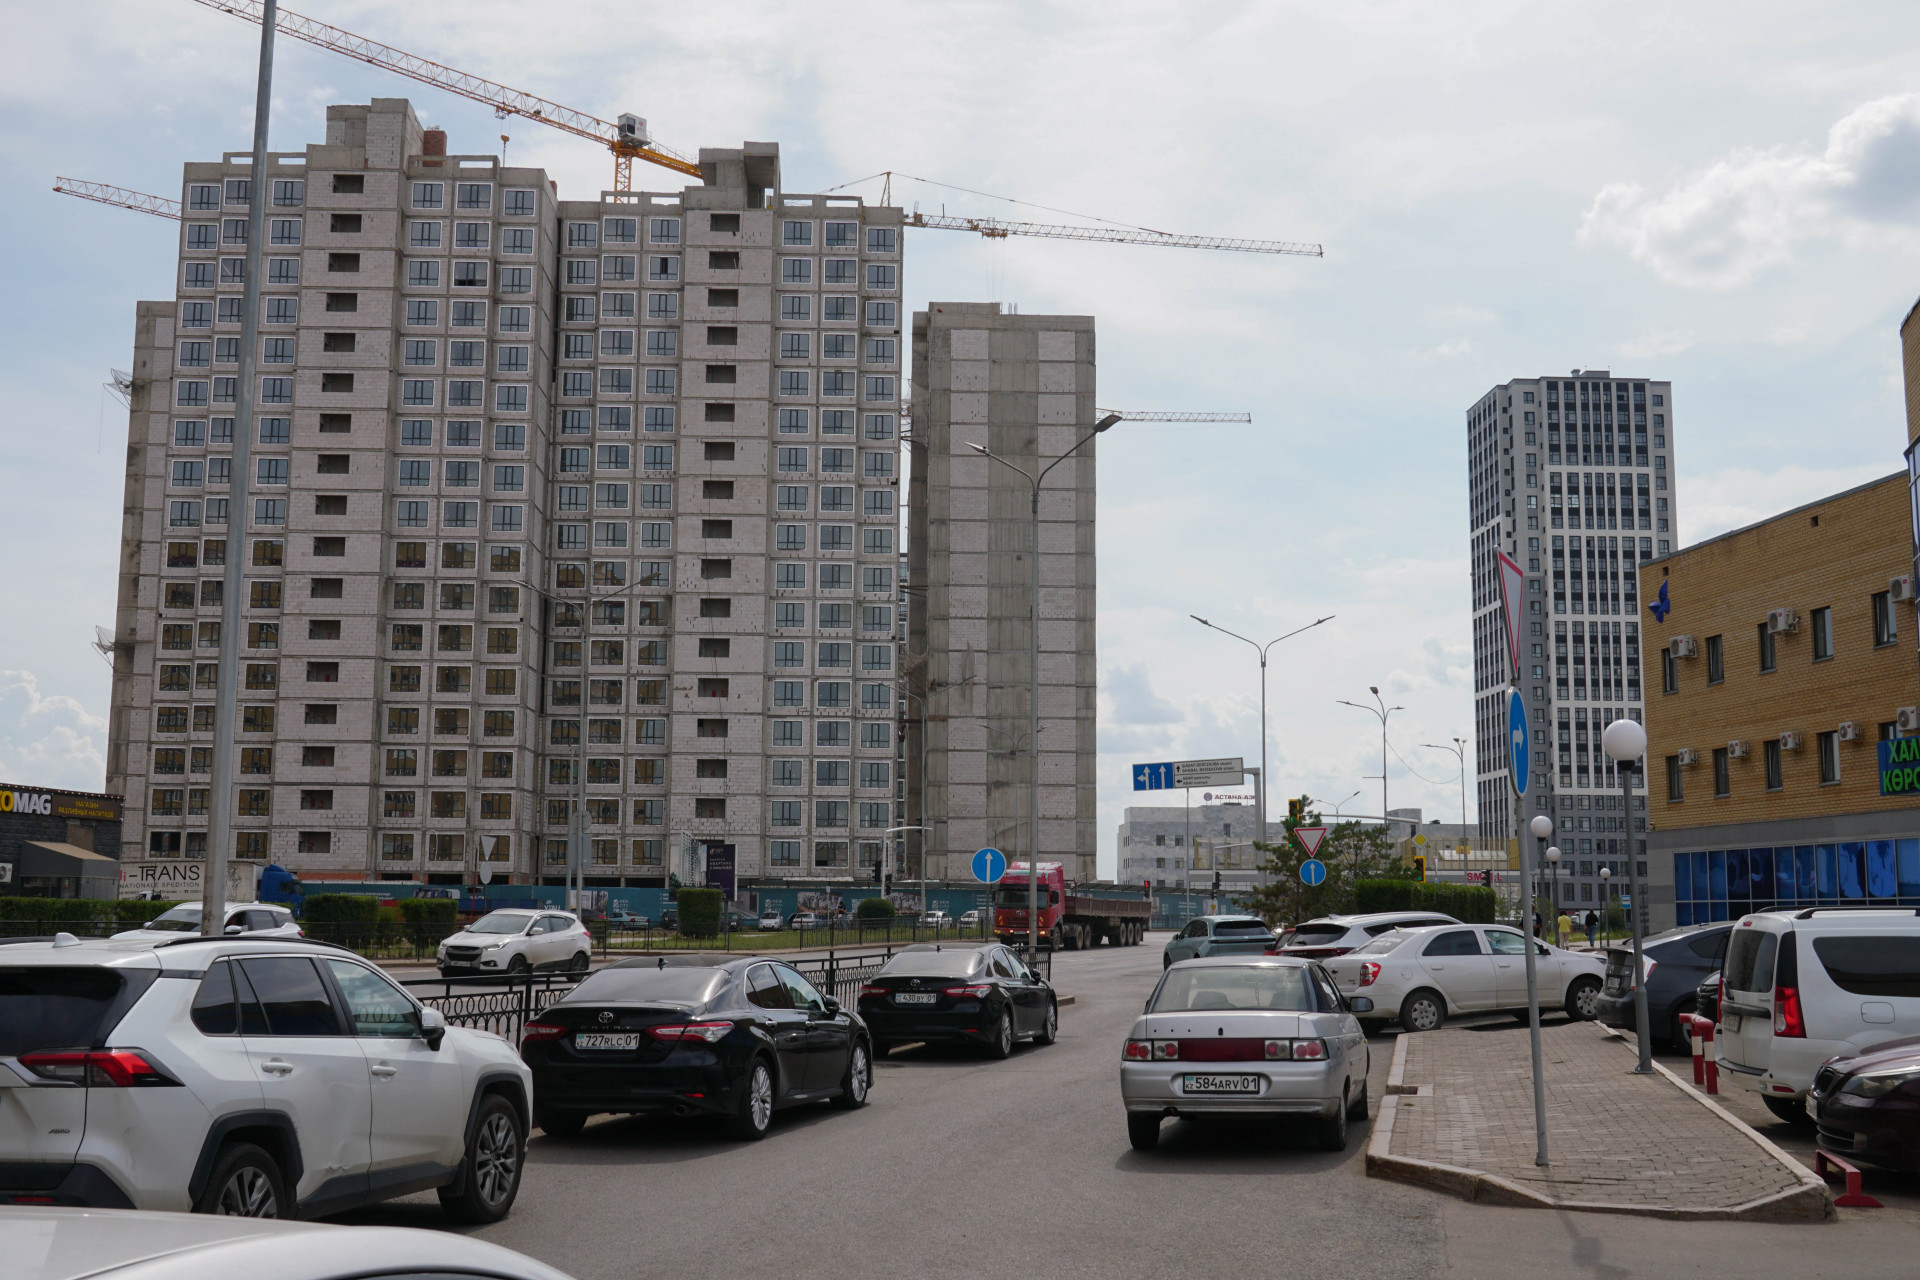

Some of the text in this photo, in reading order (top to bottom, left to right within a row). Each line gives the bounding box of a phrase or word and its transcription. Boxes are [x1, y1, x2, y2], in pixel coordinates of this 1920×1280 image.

[1888, 738, 1920, 763] ХАЛ
[0, 790, 51, 815] OMAG
[75, 800, 99, 809] МАГАЗИН
[1466, 872, 1504, 881] SMLL
[585, 1035, 623, 1047] 727RLC
[625, 1035, 639, 1047] 01
[1195, 1077, 1240, 1090] 584ARV
[1242, 1077, 1258, 1090] 01
